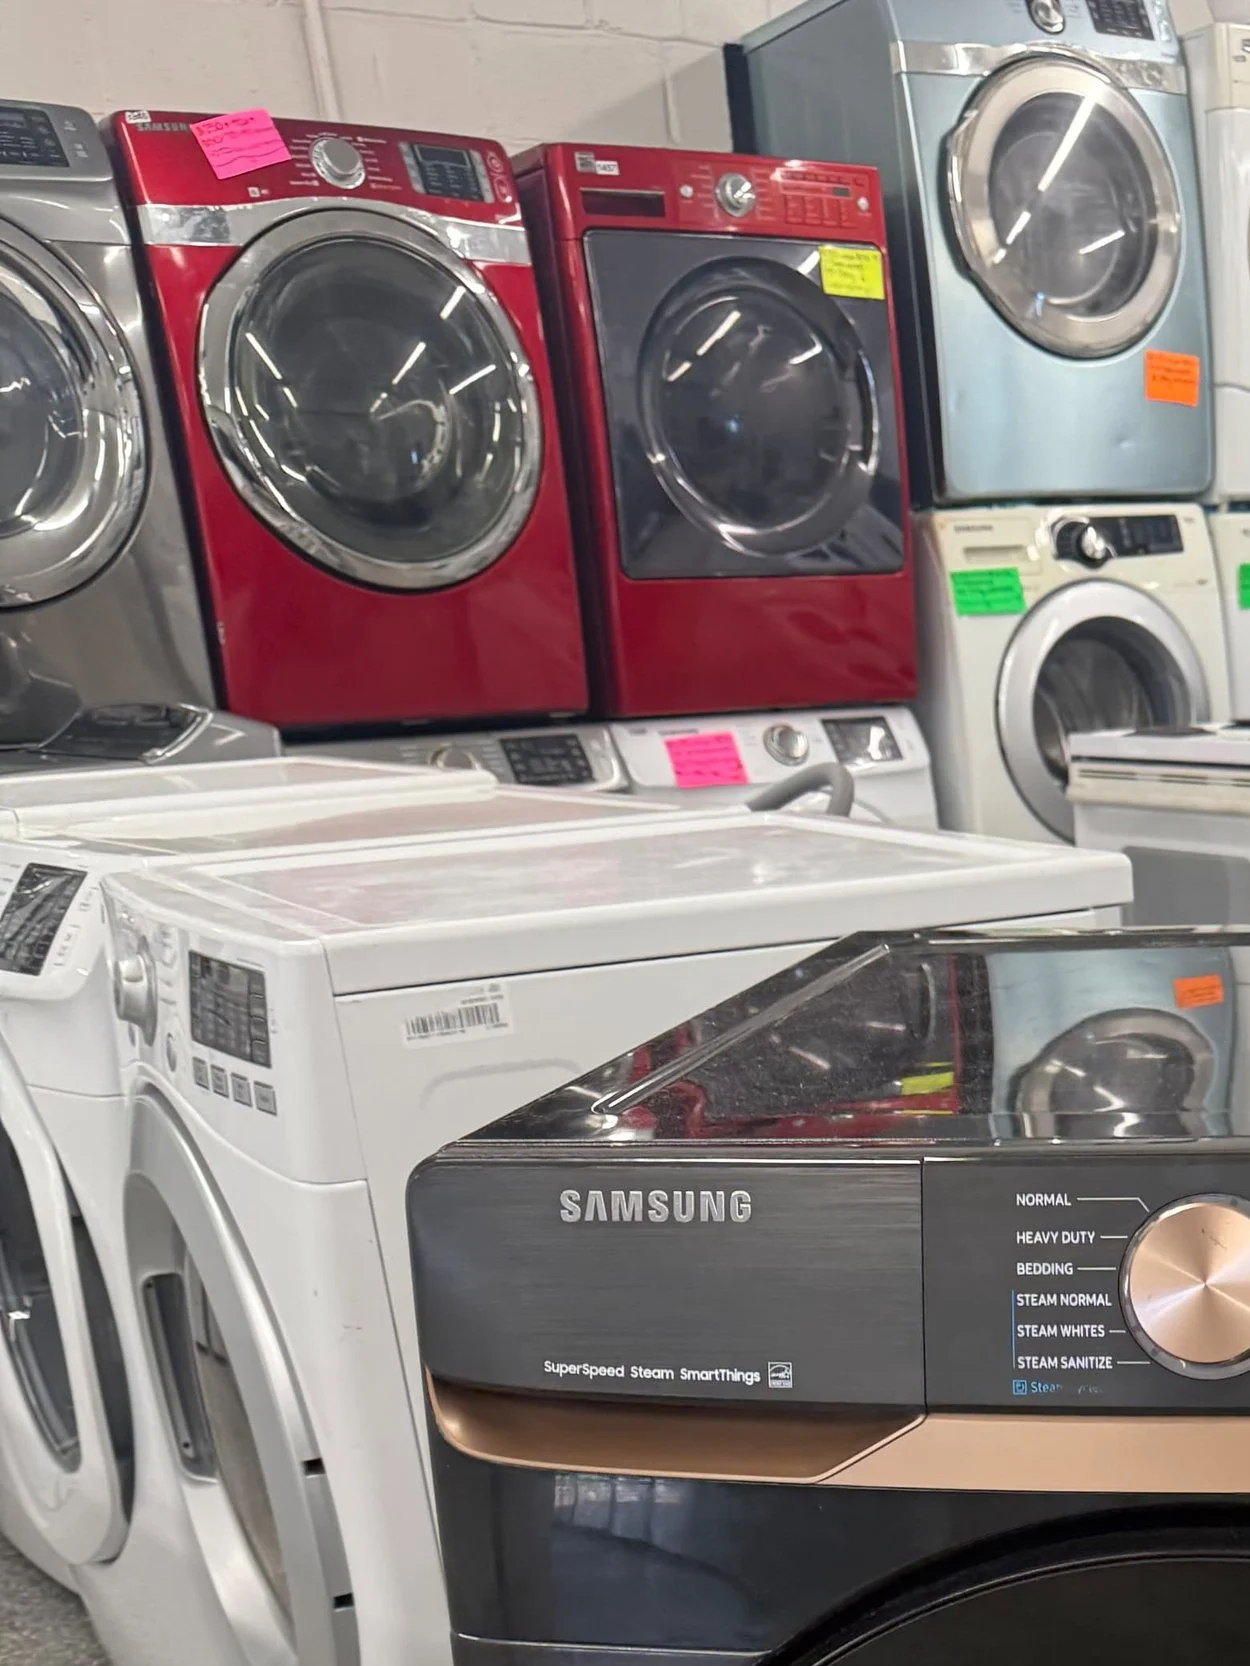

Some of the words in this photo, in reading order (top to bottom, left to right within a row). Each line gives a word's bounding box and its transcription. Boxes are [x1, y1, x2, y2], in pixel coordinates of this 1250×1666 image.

[559, 1189, 752, 1223] SAMSUNG
[1016, 1193, 1072, 1207] NORMAL
[1016, 1231, 1059, 1244] HEAVY
[1061, 1230, 1096, 1244] DUTY
[1016, 1262, 1074, 1276] BEDDING
[1016, 1293, 1058, 1307] STEAM
[1060, 1293, 1113, 1307] NORMAL
[1017, 1324, 1058, 1338] STEAM
[1060, 1324, 1105, 1338] WHITES
[1017, 1355, 1058, 1369] STEAM
[1060, 1355, 1113, 1370] SANITIZE
[544, 1360, 625, 1380] SuperSpeed
[630, 1365, 675, 1380] Steam
[679, 1367, 761, 1386] SmartThings
